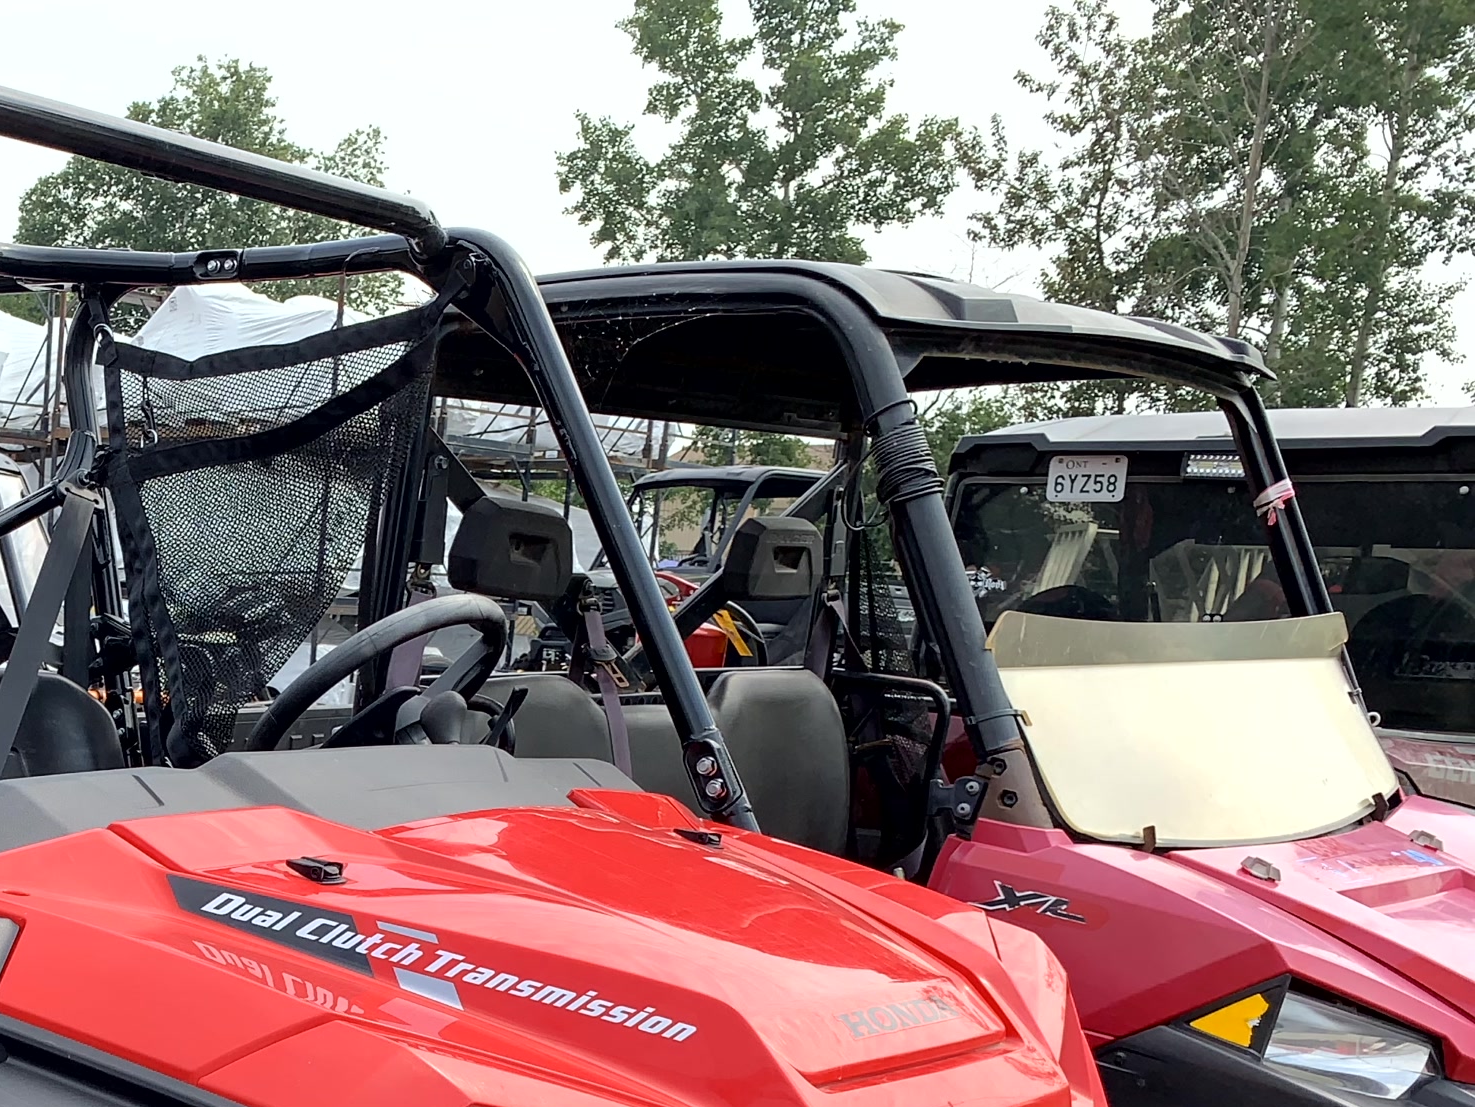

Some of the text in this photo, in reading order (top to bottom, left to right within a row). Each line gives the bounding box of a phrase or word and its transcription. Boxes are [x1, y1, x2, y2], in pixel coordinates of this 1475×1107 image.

[1066, 460, 1088, 470] ONT
[1054, 474, 1118, 493] 6YZ58
[200, 892, 697, 1042] Dual Clutch Transmission
[840, 995, 960, 1038] HONDA
